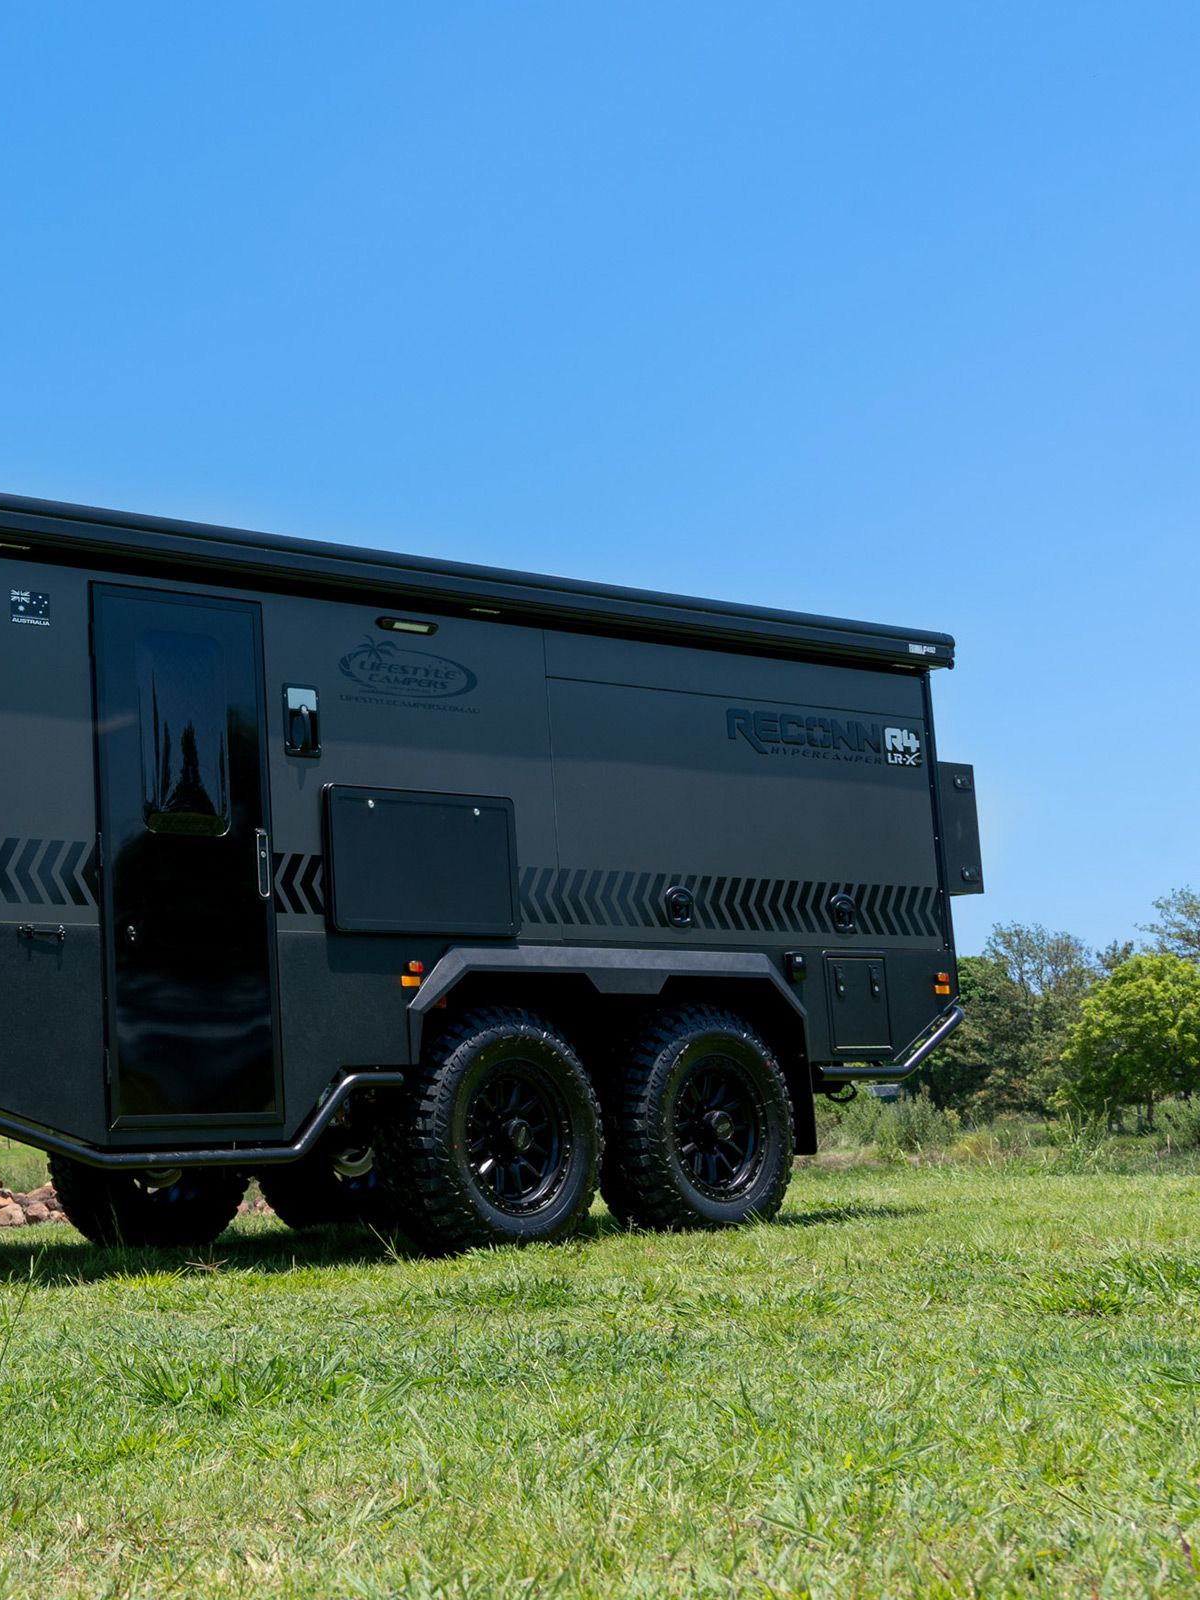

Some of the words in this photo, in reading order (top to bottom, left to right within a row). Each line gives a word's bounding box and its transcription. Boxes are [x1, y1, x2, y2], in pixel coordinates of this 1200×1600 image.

[11, 617, 50, 627] AUSTRALIA
[359, 660, 457, 680] LIFESTYLE
[368, 673, 449, 690] CAMPERS
[726, 708, 881, 754] RECONN
[885, 727, 920, 753] R4
[771, 746, 882, 765] HYPERCAMPER
